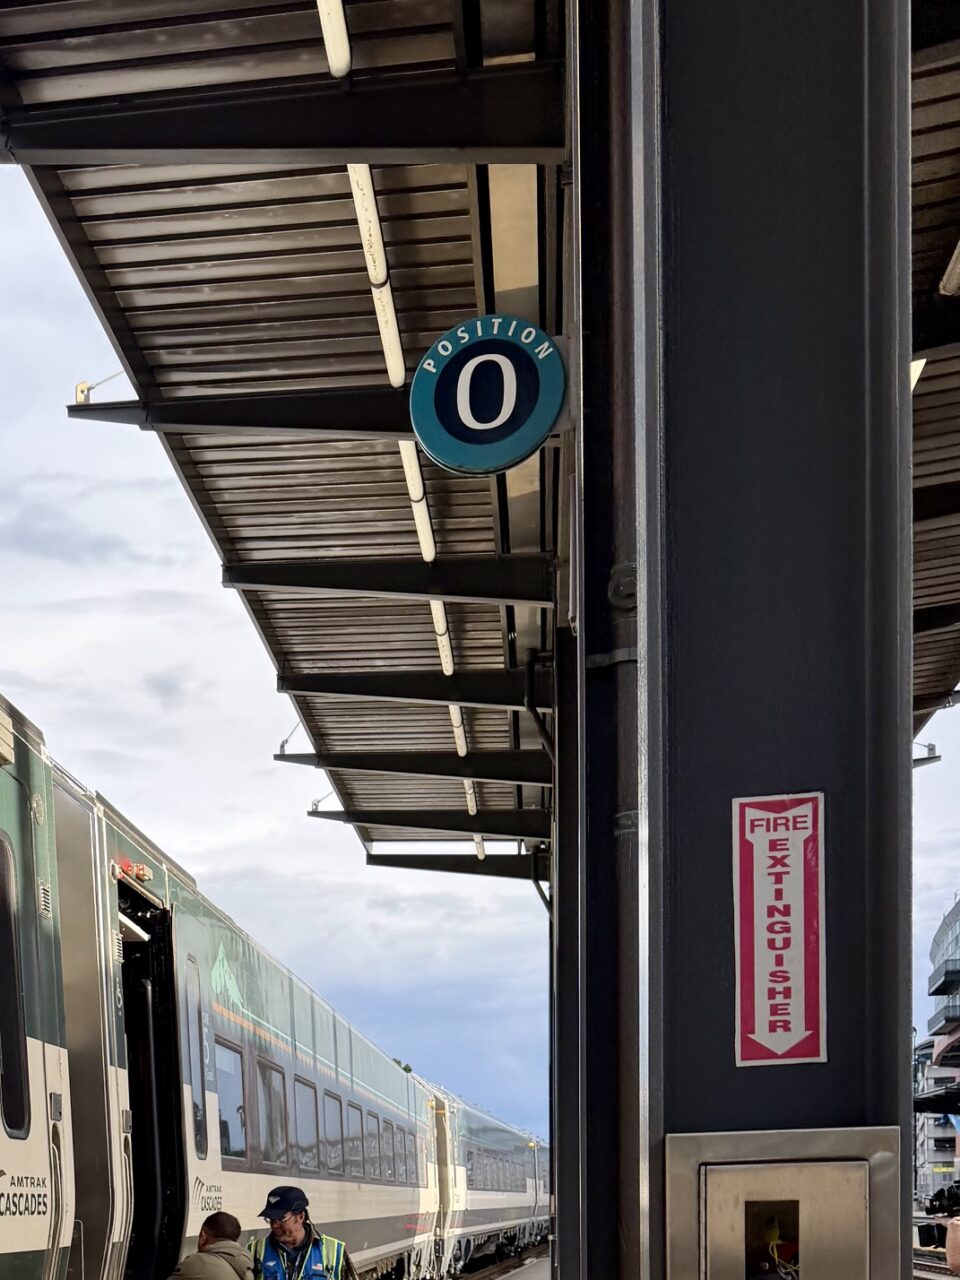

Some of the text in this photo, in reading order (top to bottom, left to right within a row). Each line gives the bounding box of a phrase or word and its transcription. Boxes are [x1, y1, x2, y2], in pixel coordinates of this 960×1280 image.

[423, 318, 554, 373] POSITION
[749, 814, 809, 834] FIRE
[766, 837, 793, 1034] EXTINGUISHER
[10, 1176, 47, 1189] AMTRAK
